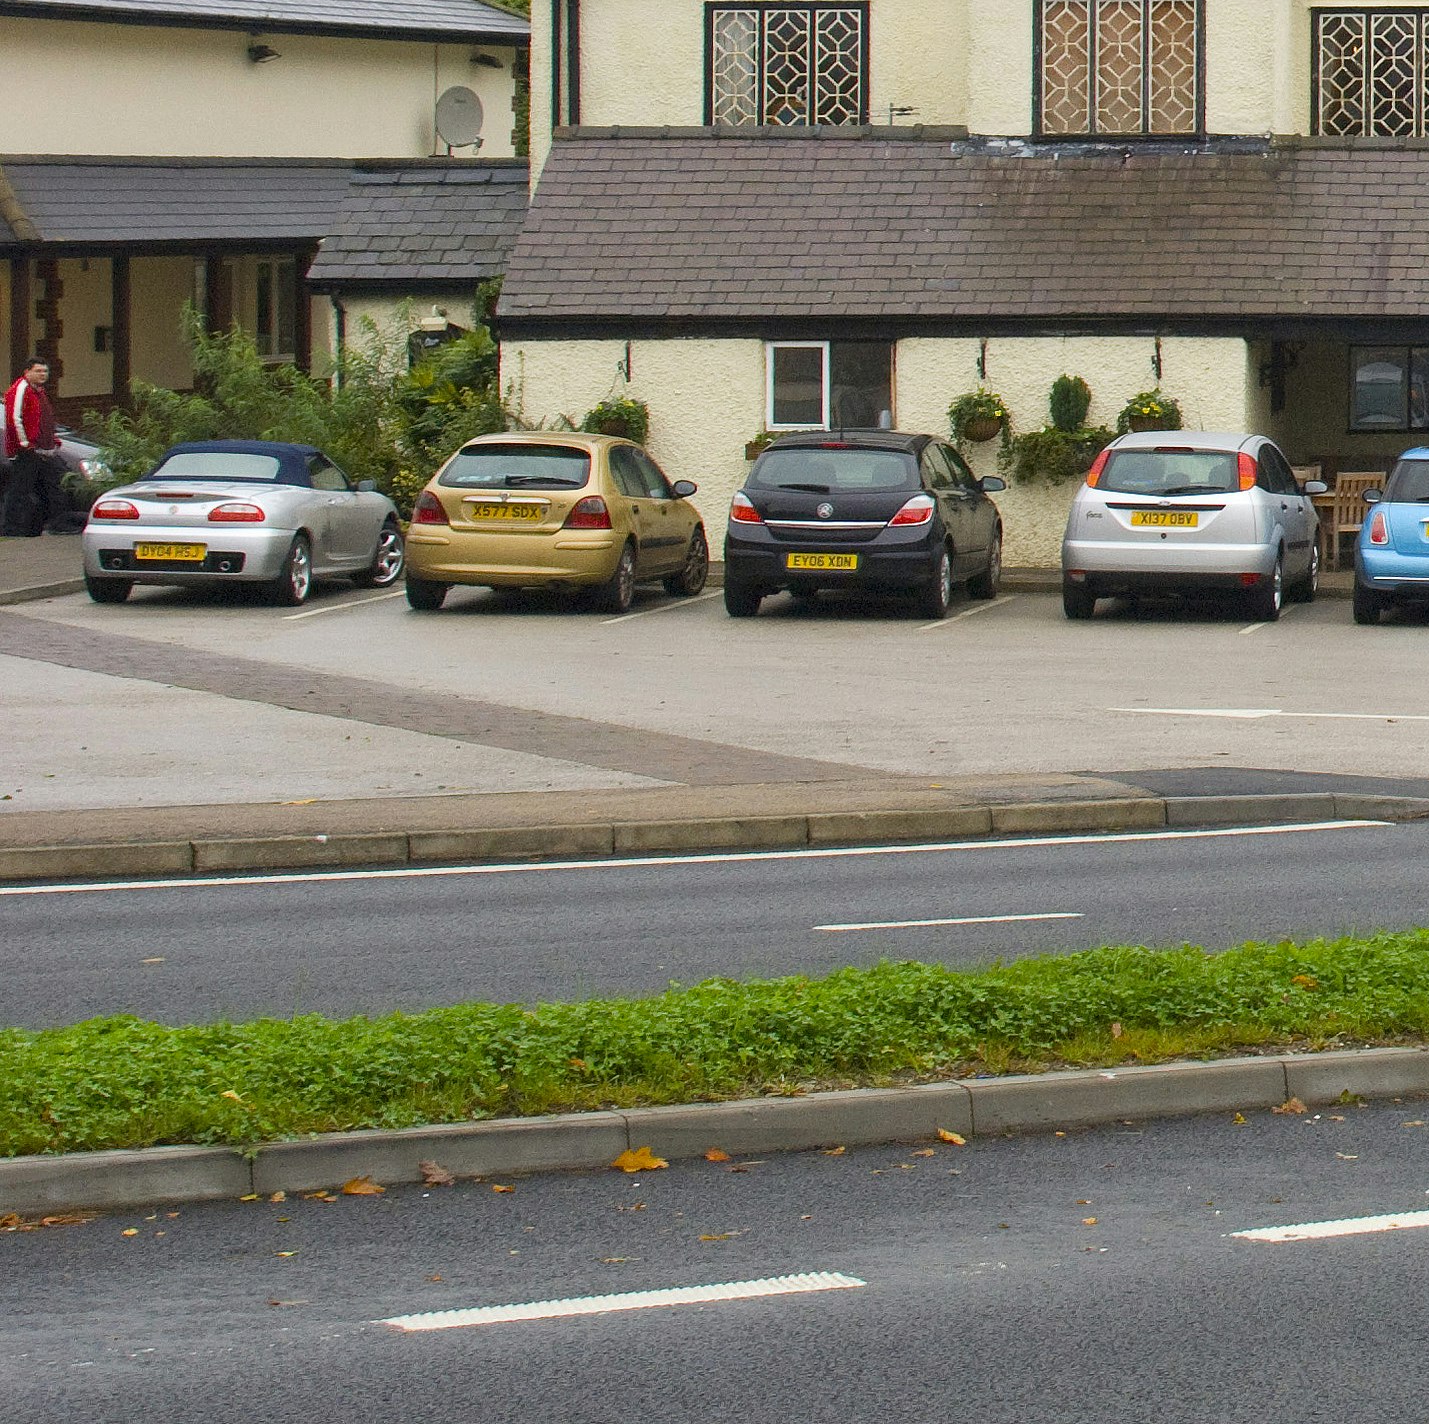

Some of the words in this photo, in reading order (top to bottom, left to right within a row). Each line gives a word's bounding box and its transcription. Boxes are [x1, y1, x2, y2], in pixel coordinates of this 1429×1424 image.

[473, 504, 509, 517] X577
[512, 506, 538, 518] SDX
[1141, 512, 1166, 524] X137
[793, 555, 824, 566] EY06
